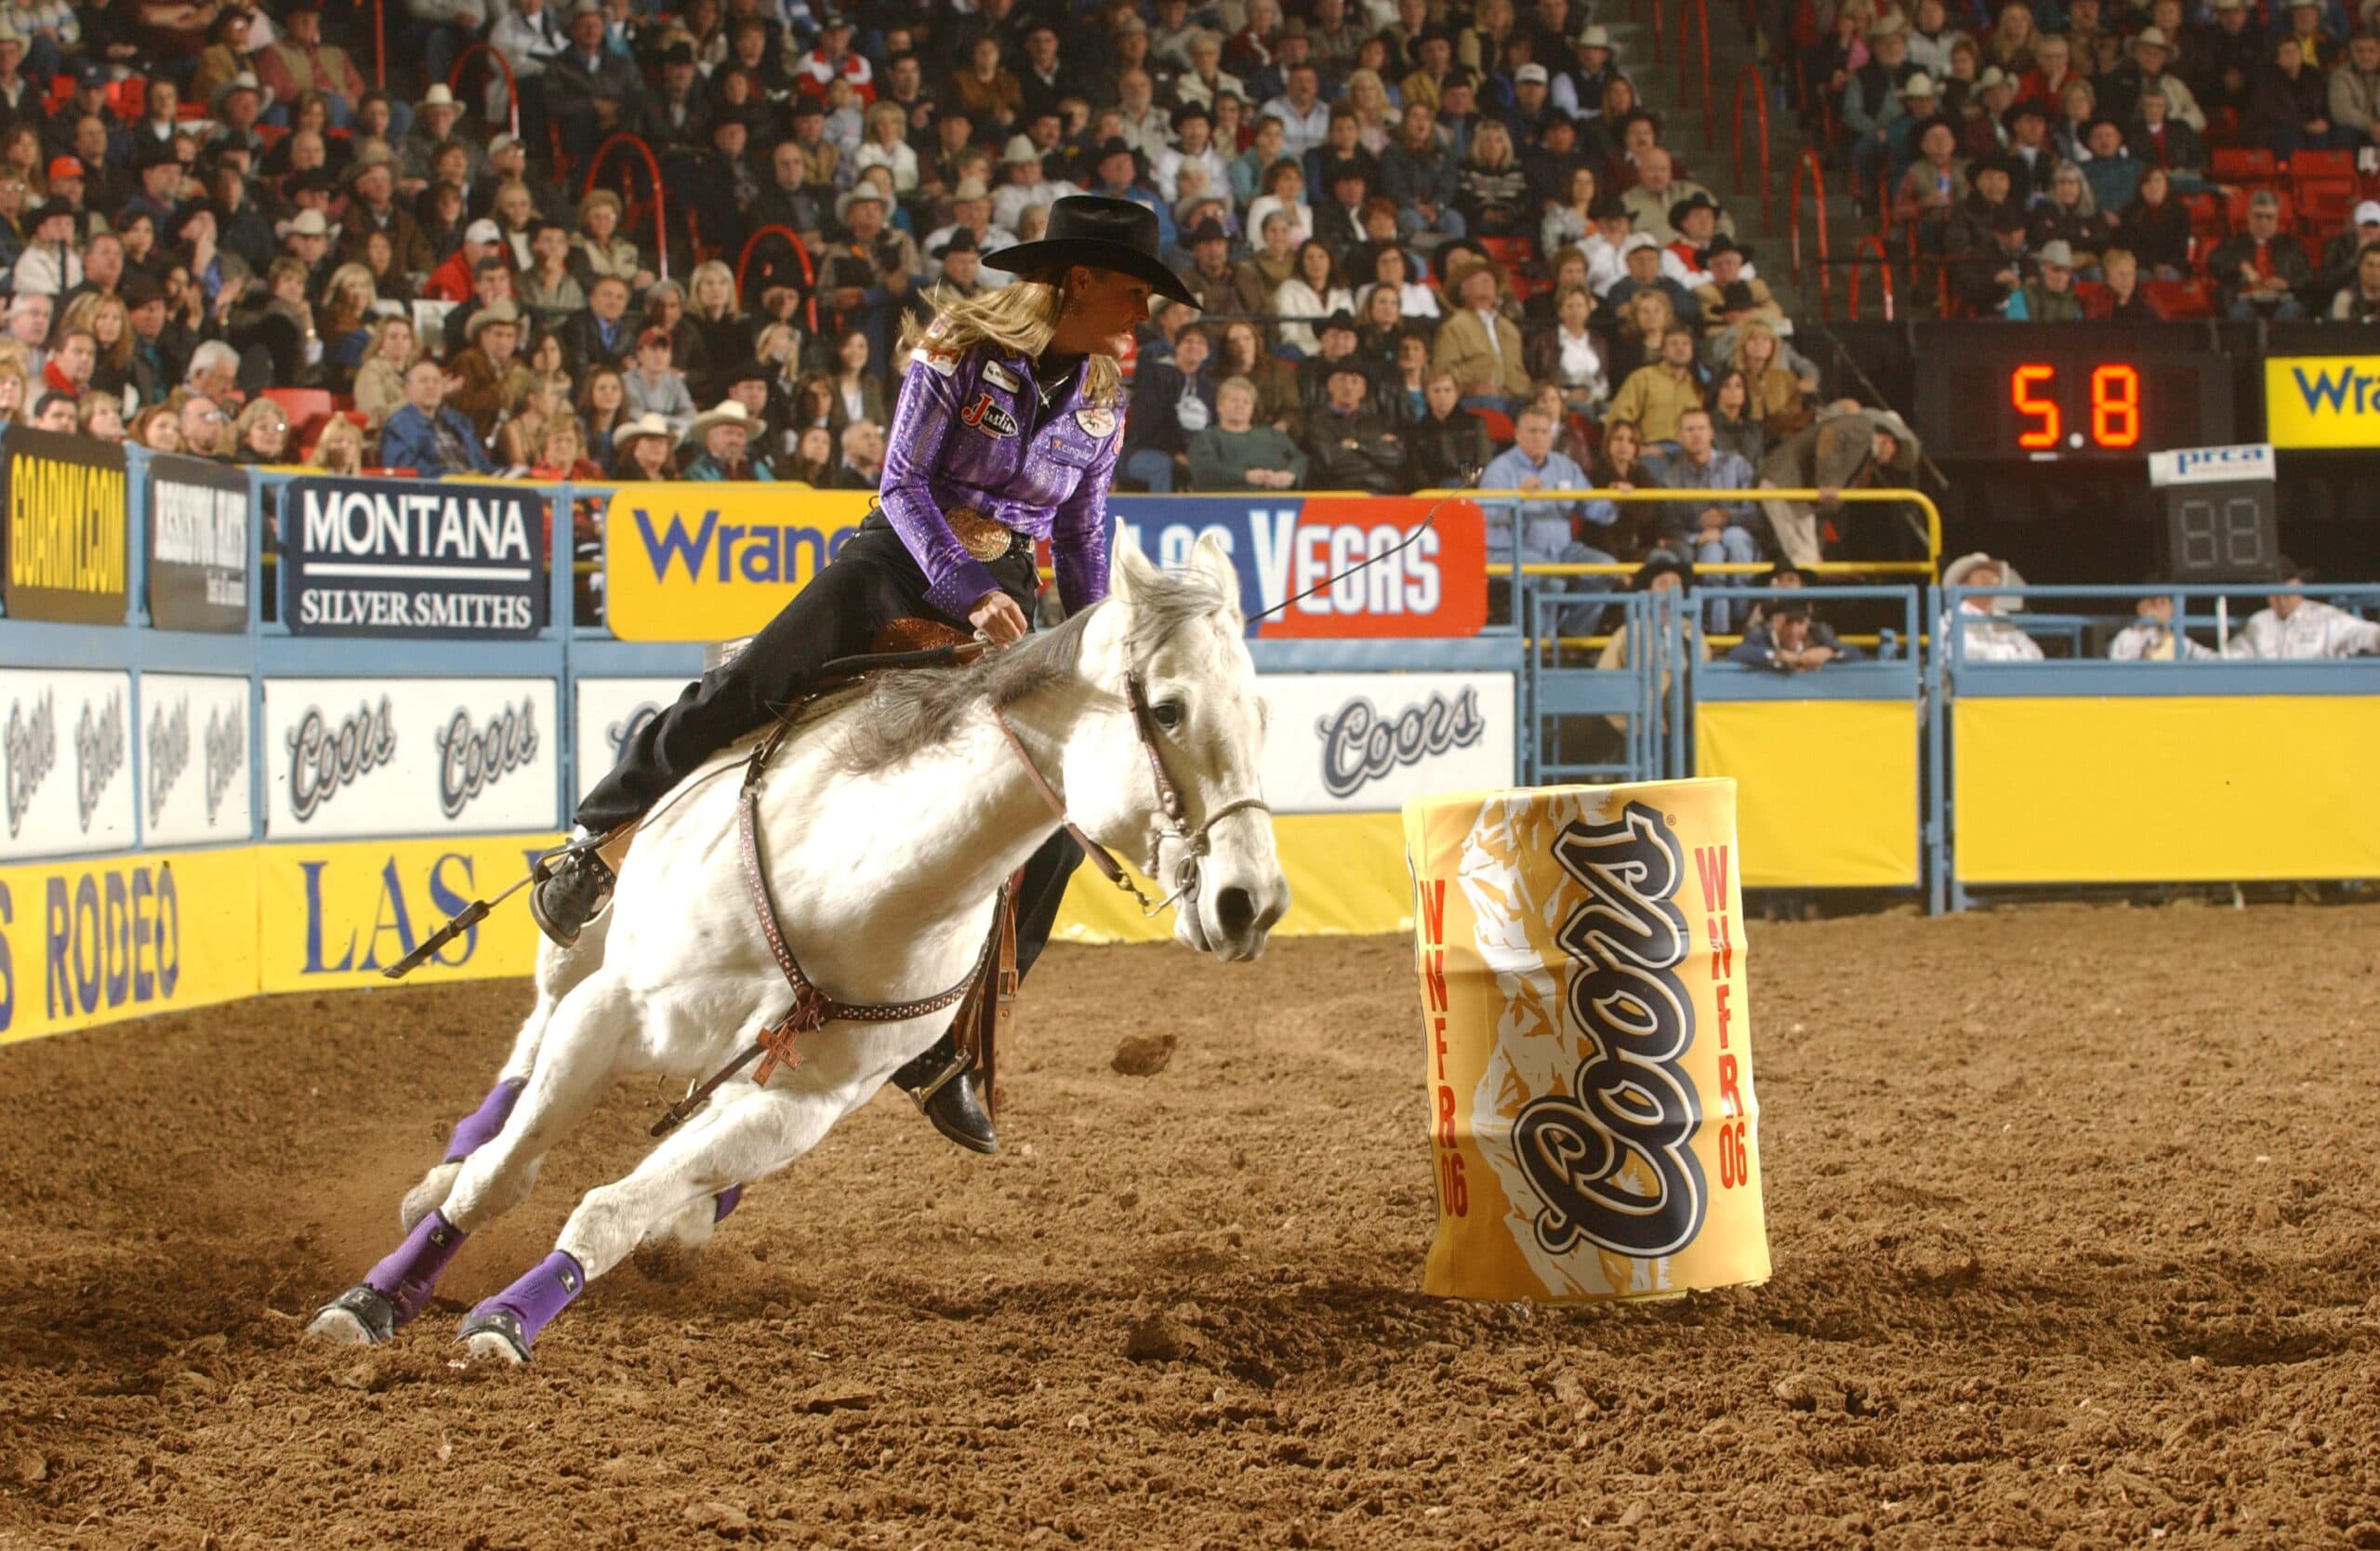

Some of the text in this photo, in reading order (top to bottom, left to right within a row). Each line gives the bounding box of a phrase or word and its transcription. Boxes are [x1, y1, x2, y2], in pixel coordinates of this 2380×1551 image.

[961, 392, 1016, 436] Justin
[2012, 364, 2139, 448] 5.8
[2178, 448, 2263, 475] prca
[11, 453, 125, 595] GOARMY.COM
[303, 489, 532, 561] MONTANA
[1249, 510, 1441, 623] VEGAS
[285, 694, 397, 822] Coors
[435, 696, 539, 819] Coors
[1315, 683, 1485, 798] Coors
[46, 861, 178, 1019] RODEO
[298, 853, 478, 974] LAS
[1510, 801, 1708, 1259] Coors
